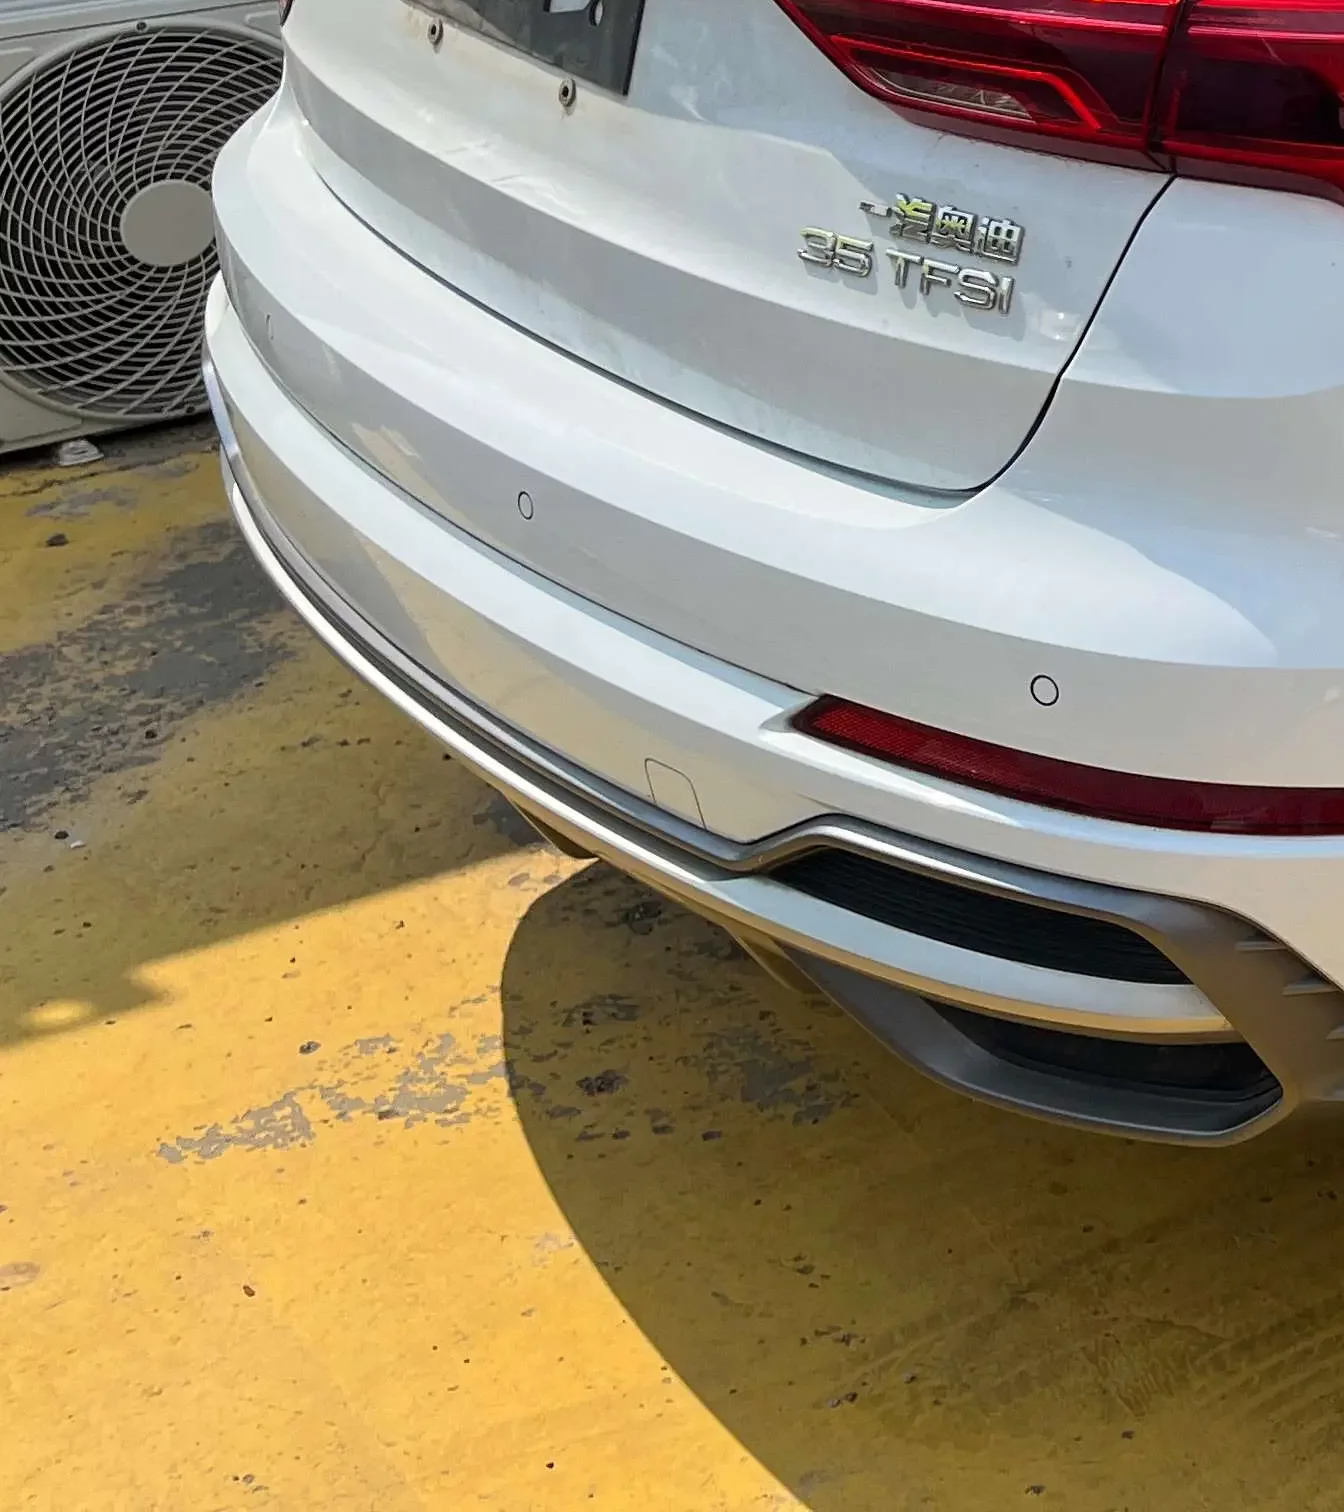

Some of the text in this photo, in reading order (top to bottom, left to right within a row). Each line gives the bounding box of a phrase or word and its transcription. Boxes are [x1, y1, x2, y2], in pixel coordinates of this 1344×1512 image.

[797, 226, 1016, 315] 35 TFSI
[857, 192, 1026, 267] 一汽奥迪
